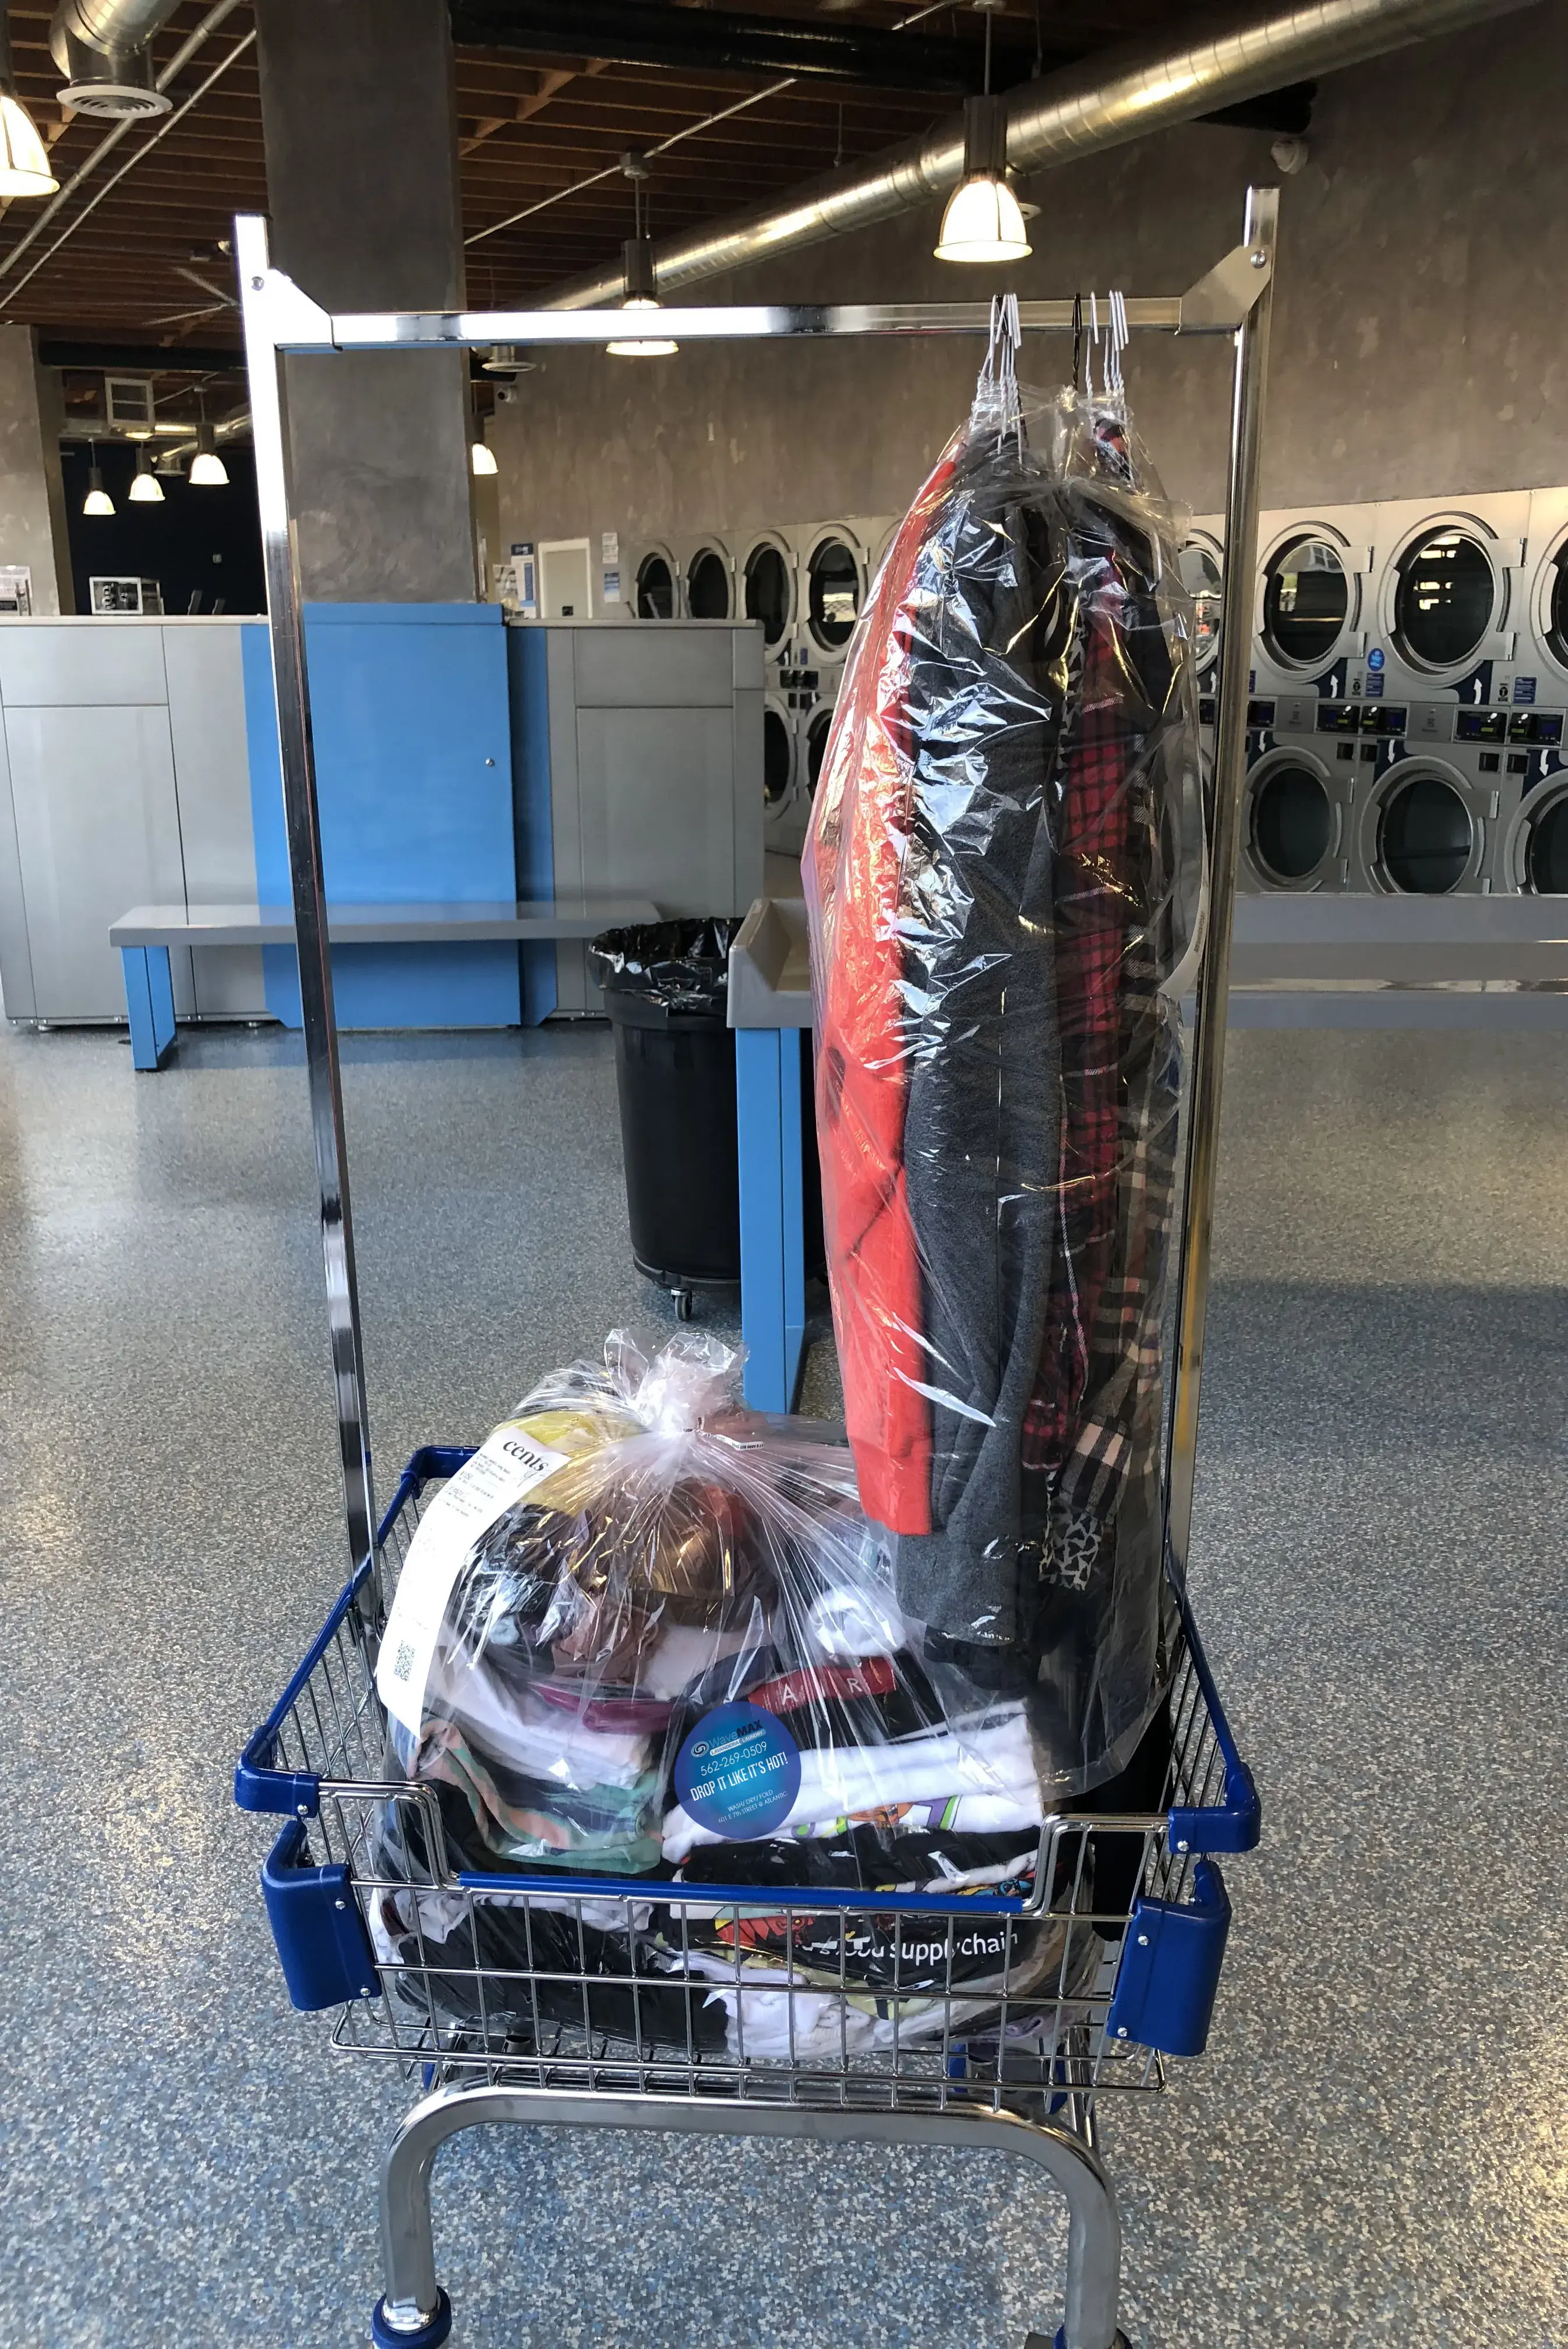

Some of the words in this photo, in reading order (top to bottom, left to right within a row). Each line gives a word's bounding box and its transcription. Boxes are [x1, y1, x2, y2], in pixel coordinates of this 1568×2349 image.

[503, 1441, 549, 1472] cents
[708, 1720, 764, 1748] WaveMAX
[711, 1741, 740, 1755] LAVANDERIA
[741, 1730, 763, 1743] LAUNDRY
[701, 1741, 767, 1776] 562-269-0509
[690, 1780, 716, 1801] DROP
[717, 1776, 727, 1791] IT
[727, 1768, 748, 1787] LIKE
[747, 1761, 767, 1779] IT'S
[766, 1751, 788, 1771] HOT!
[741, 1804, 758, 1814] STREET
[764, 1791, 788, 1805] ATLANTIC
[759, 1789, 774, 1799] FOLD
